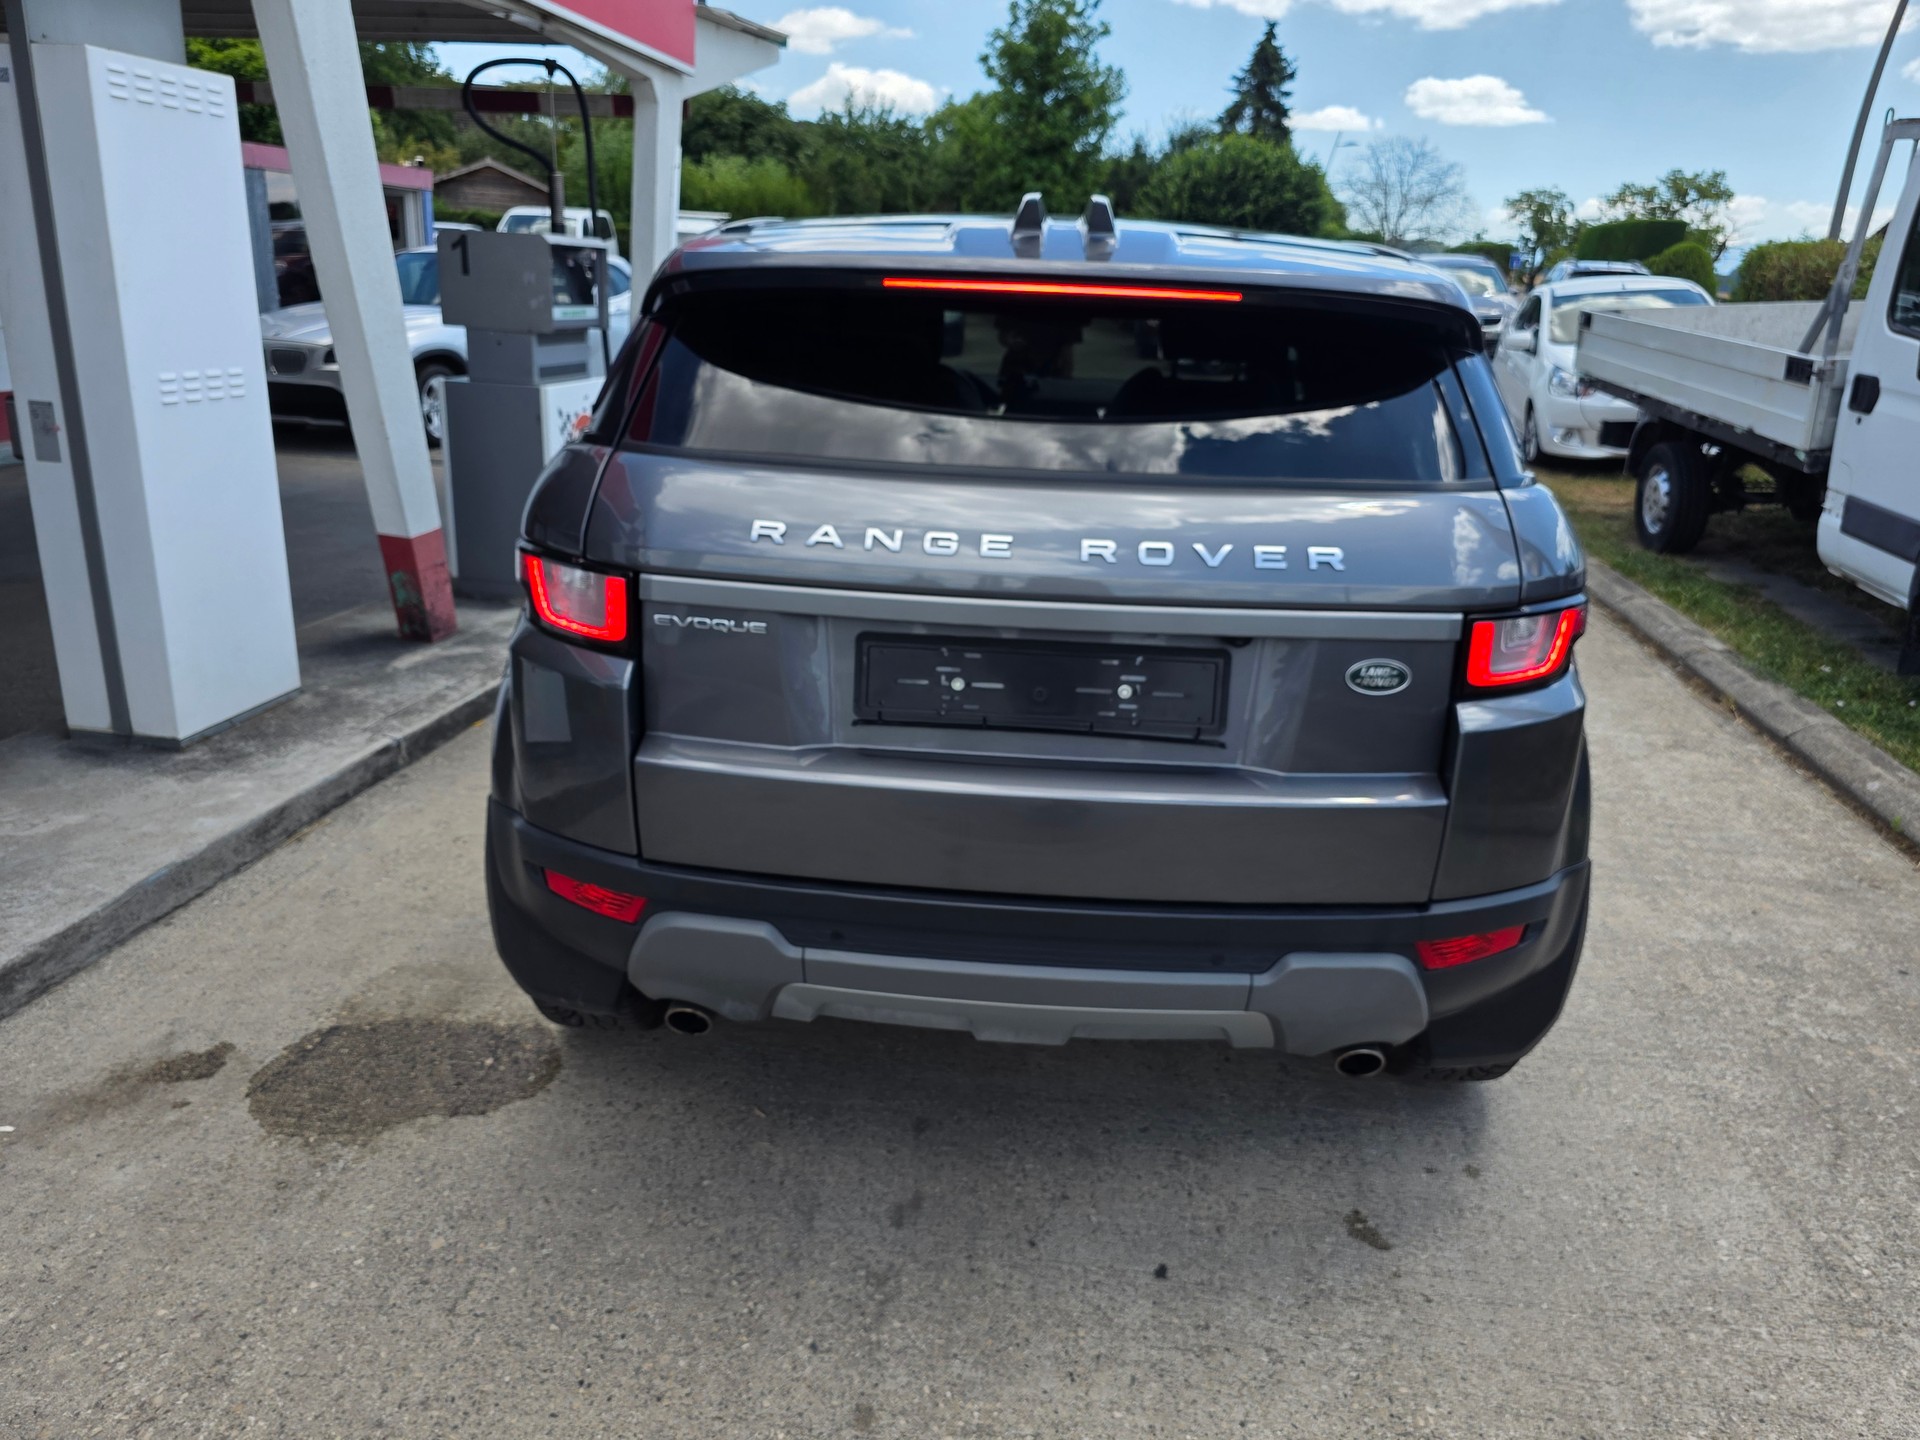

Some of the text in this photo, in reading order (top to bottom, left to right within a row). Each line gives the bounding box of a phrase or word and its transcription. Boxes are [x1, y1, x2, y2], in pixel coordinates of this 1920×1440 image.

[451, 233, 470, 277] 1
[750, 518, 1346, 572] RANGE ROVER
[653, 613, 767, 635] EVOQUE
